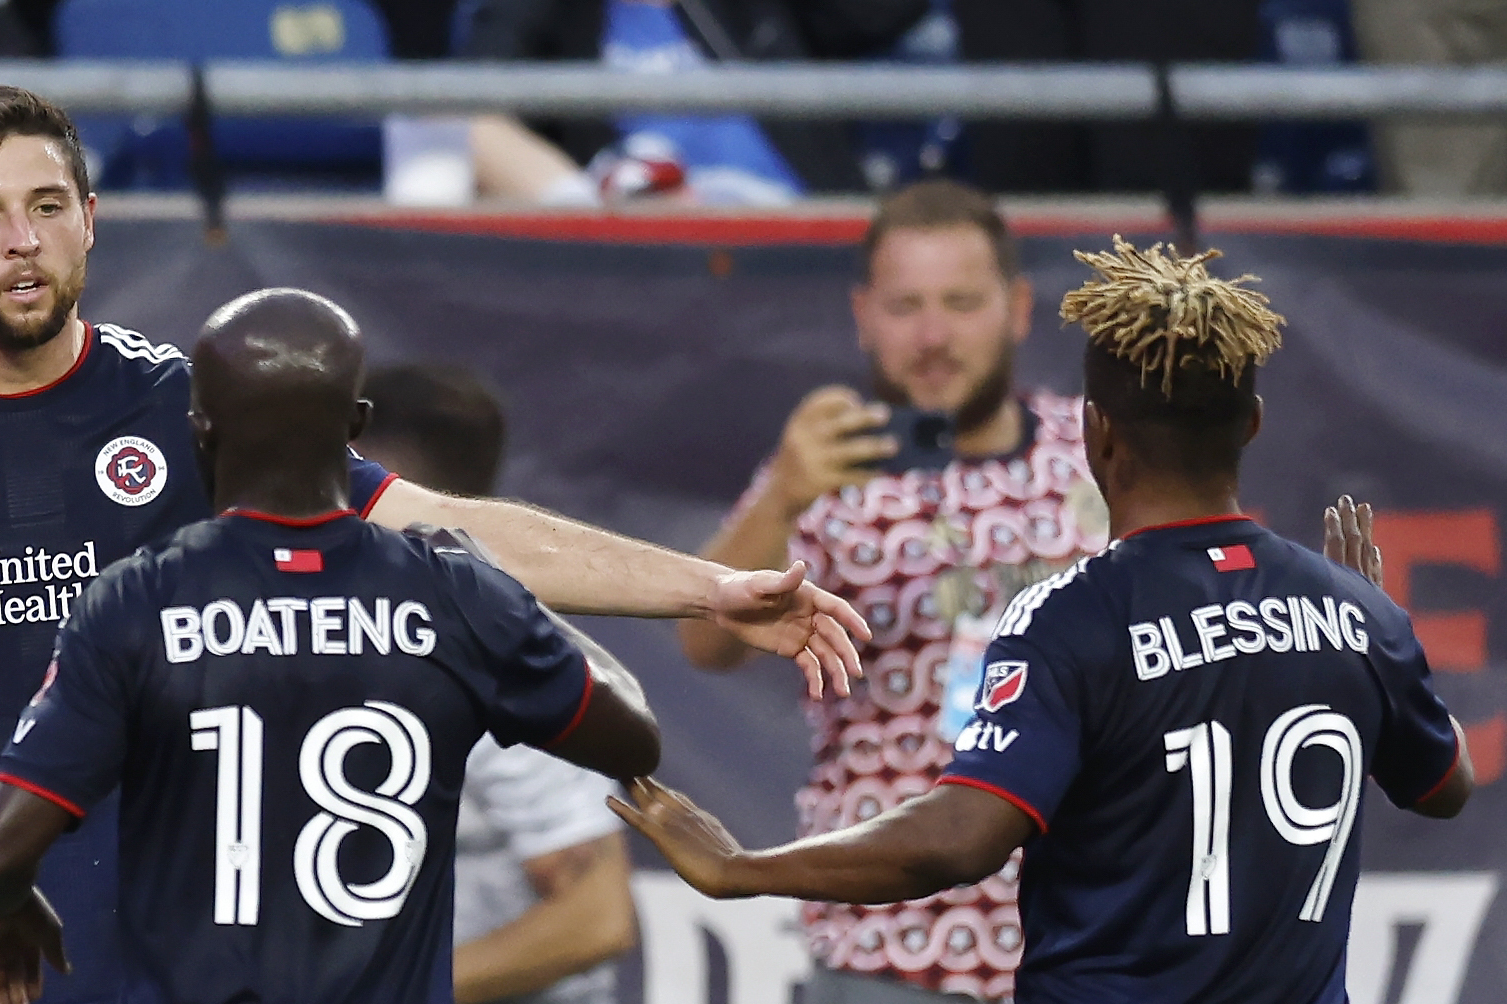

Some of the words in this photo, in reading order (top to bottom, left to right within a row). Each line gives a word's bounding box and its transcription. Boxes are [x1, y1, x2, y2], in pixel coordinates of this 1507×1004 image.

[103, 441, 119, 456] NEW
[120, 438, 156, 454] ENGLAND
[112, 488, 156, 504] REVOLUTION
[160, 597, 437, 663] BOATENG
[1128, 596, 1370, 681] BLESSING
[189, 699, 433, 927] 18
[1163, 703, 1364, 937] 19
